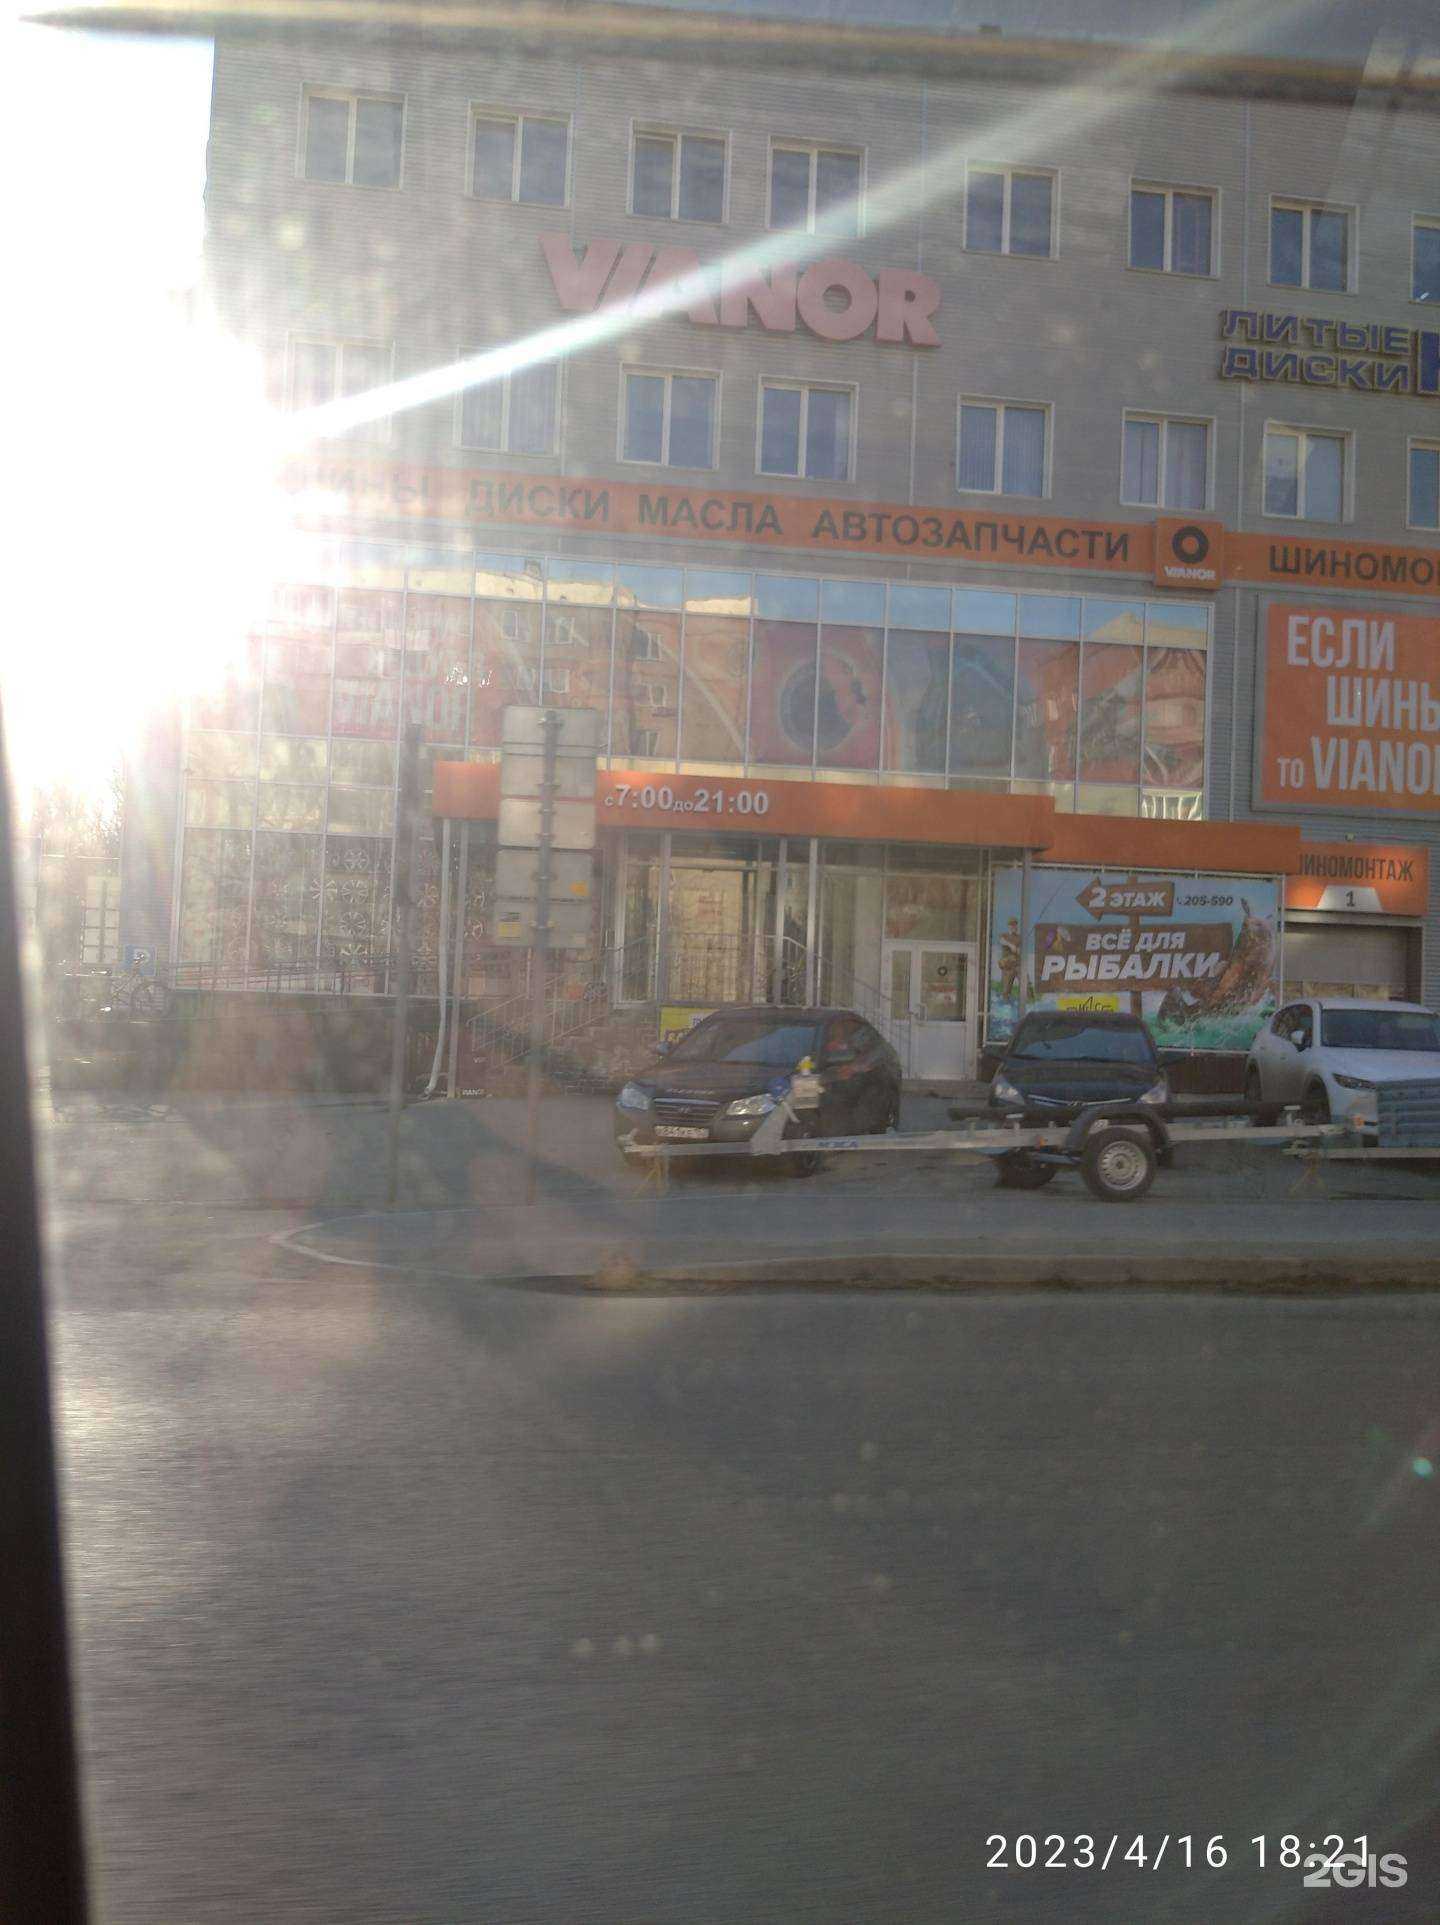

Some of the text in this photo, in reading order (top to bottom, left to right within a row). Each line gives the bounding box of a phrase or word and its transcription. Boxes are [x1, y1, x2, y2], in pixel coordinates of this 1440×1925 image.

[537, 232, 941, 348] VIANOR
[1221, 308, 1412, 355] ЛИТЫЕ
[1221, 345, 1412, 393] ДИСКИ
[465, 478, 610, 523] ДИСКИ
[637, 494, 784, 536] МАСЛА
[811, 509, 1130, 562] АВТОЗАПЧАСТИ
[1163, 564, 1217, 581] VIANOR
[1268, 544, 1440, 586] ШИНОМО
[1287, 614, 1395, 672] ЕСЛИ
[1277, 735, 1440, 796] ТО VIANO
[615, 783, 674, 810] 7:00
[672, 799, 694, 813] до
[693, 788, 769, 815] 21:00
[1298, 854, 1415, 882] ИНОМОНТАЖ
[1088, 886, 1166, 909] 2 ЭТАЖ
[1345, 891, 1355, 907] 1
[1085, 928, 1186, 954] ВСЁ ДЛЯ
[1040, 952, 1222, 982] РЫБАЛКИ
